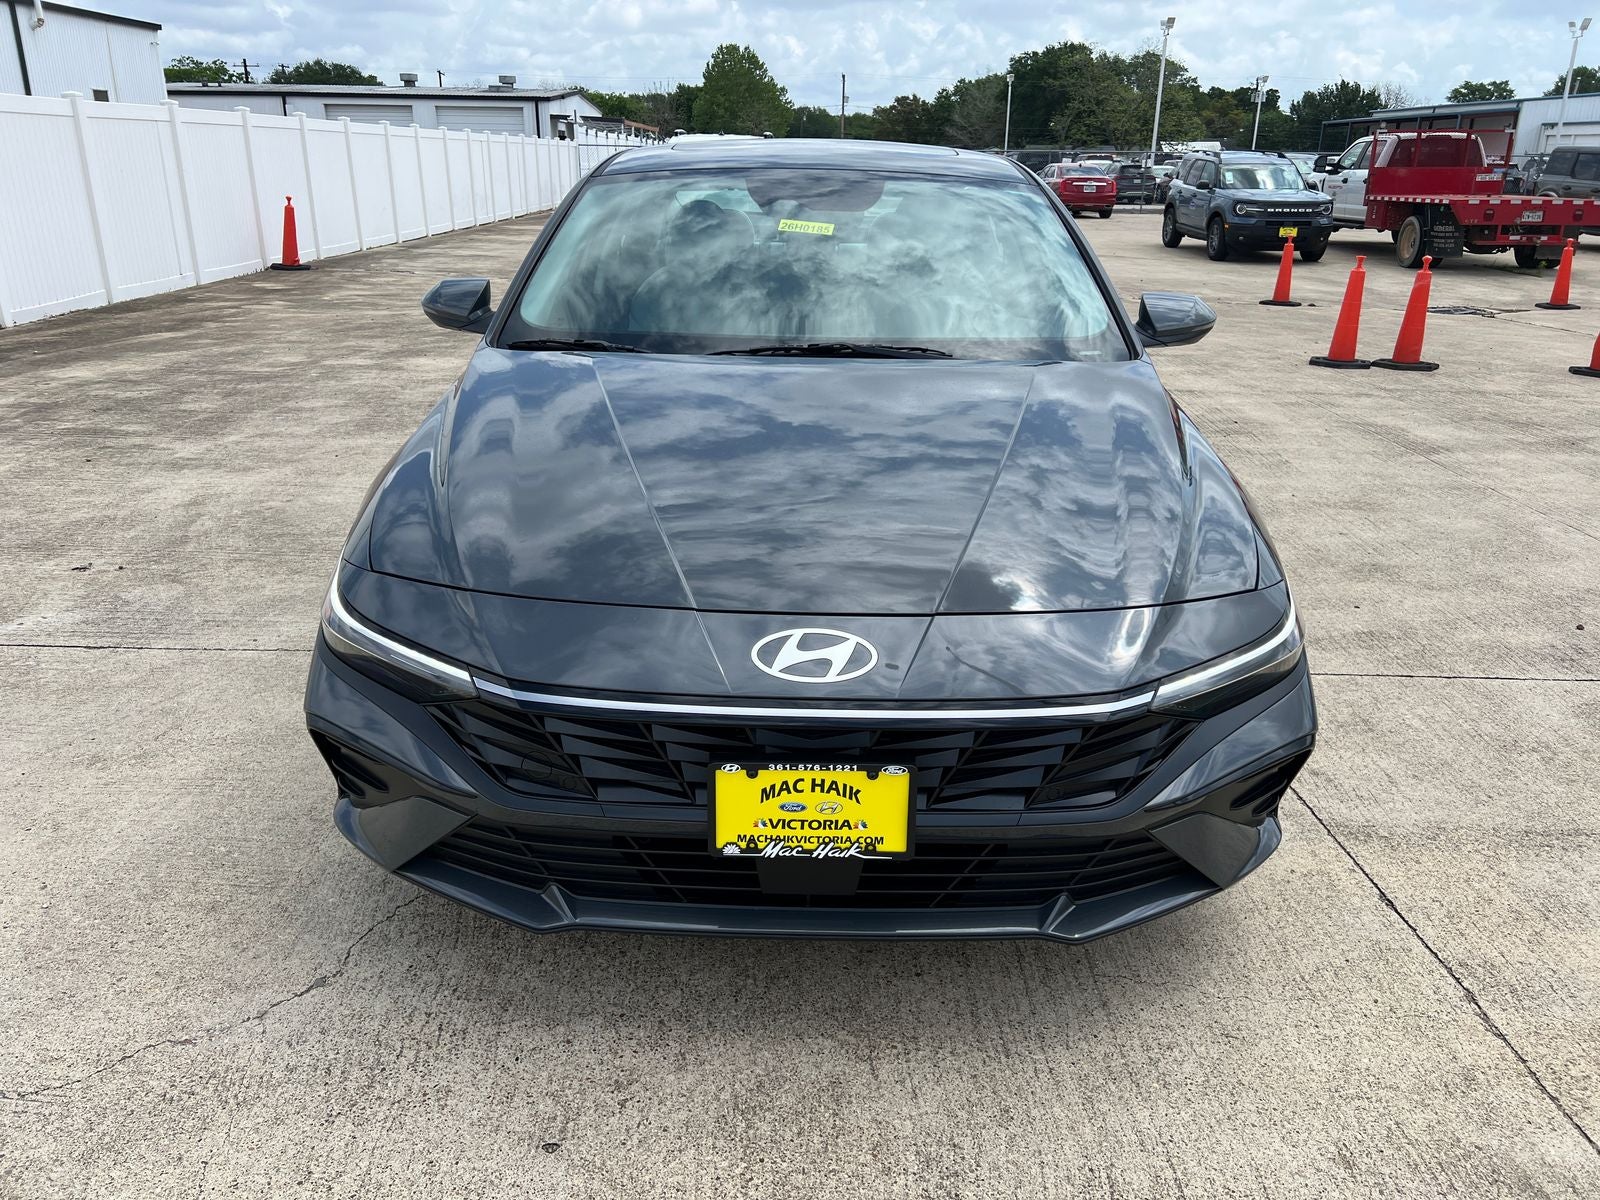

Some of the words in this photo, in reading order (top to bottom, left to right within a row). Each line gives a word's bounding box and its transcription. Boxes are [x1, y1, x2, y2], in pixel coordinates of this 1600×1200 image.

[780, 222, 831, 234] 26H0185
[768, 763, 858, 772] 361-576-1221
[760, 778, 805, 804] MAC
[810, 778, 861, 805] HAIK
[768, 818, 852, 831] VICTORIA
[737, 834, 884, 845] MACHAIKVICTORIA.COM
[760, 840, 806, 858] Mac
[811, 841, 876, 859] Haik
